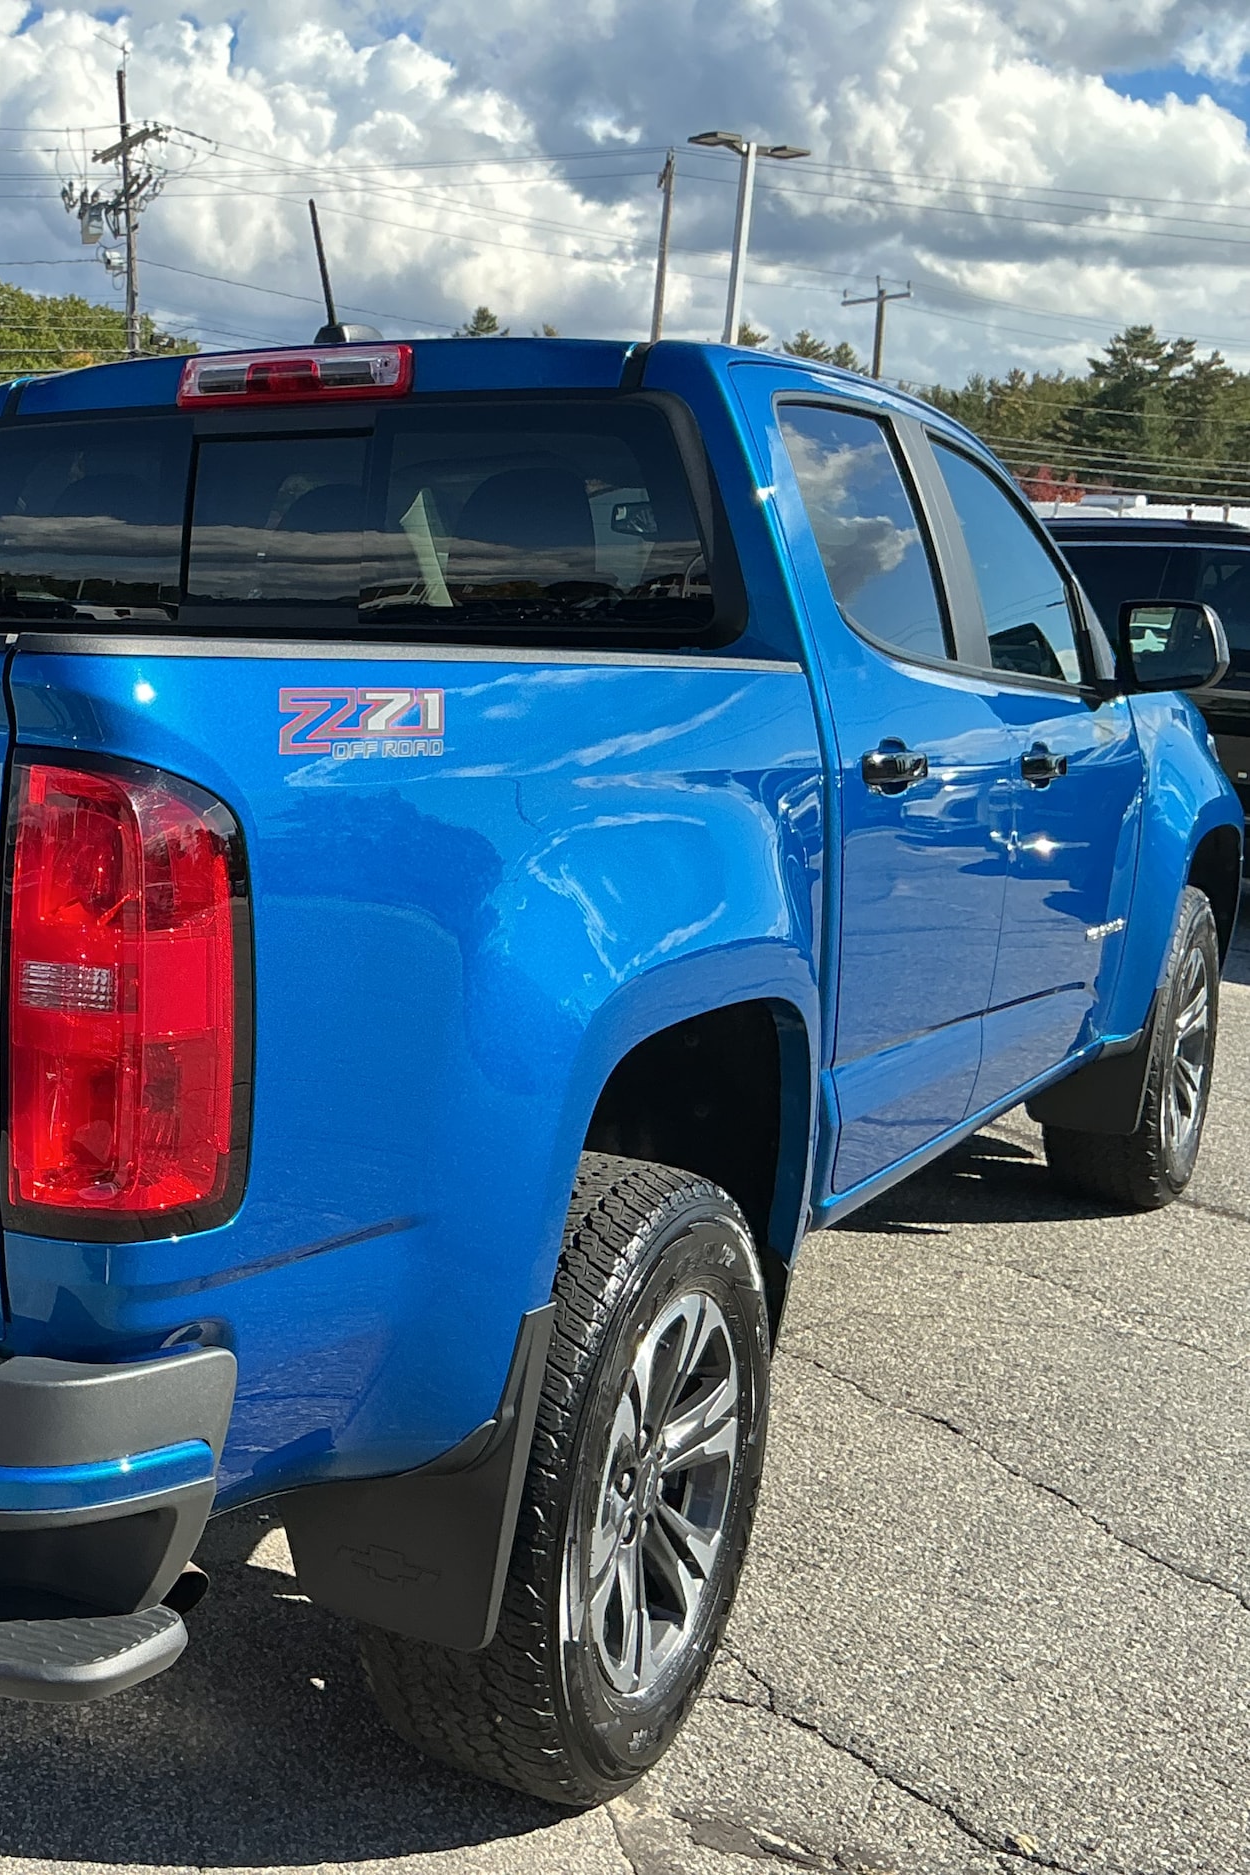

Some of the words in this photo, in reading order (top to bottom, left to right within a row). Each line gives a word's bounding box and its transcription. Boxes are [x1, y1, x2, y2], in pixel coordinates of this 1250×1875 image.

[279, 687, 445, 755] Z71
[332, 740, 378, 760] OFF
[381, 739, 444, 758] ROAD
